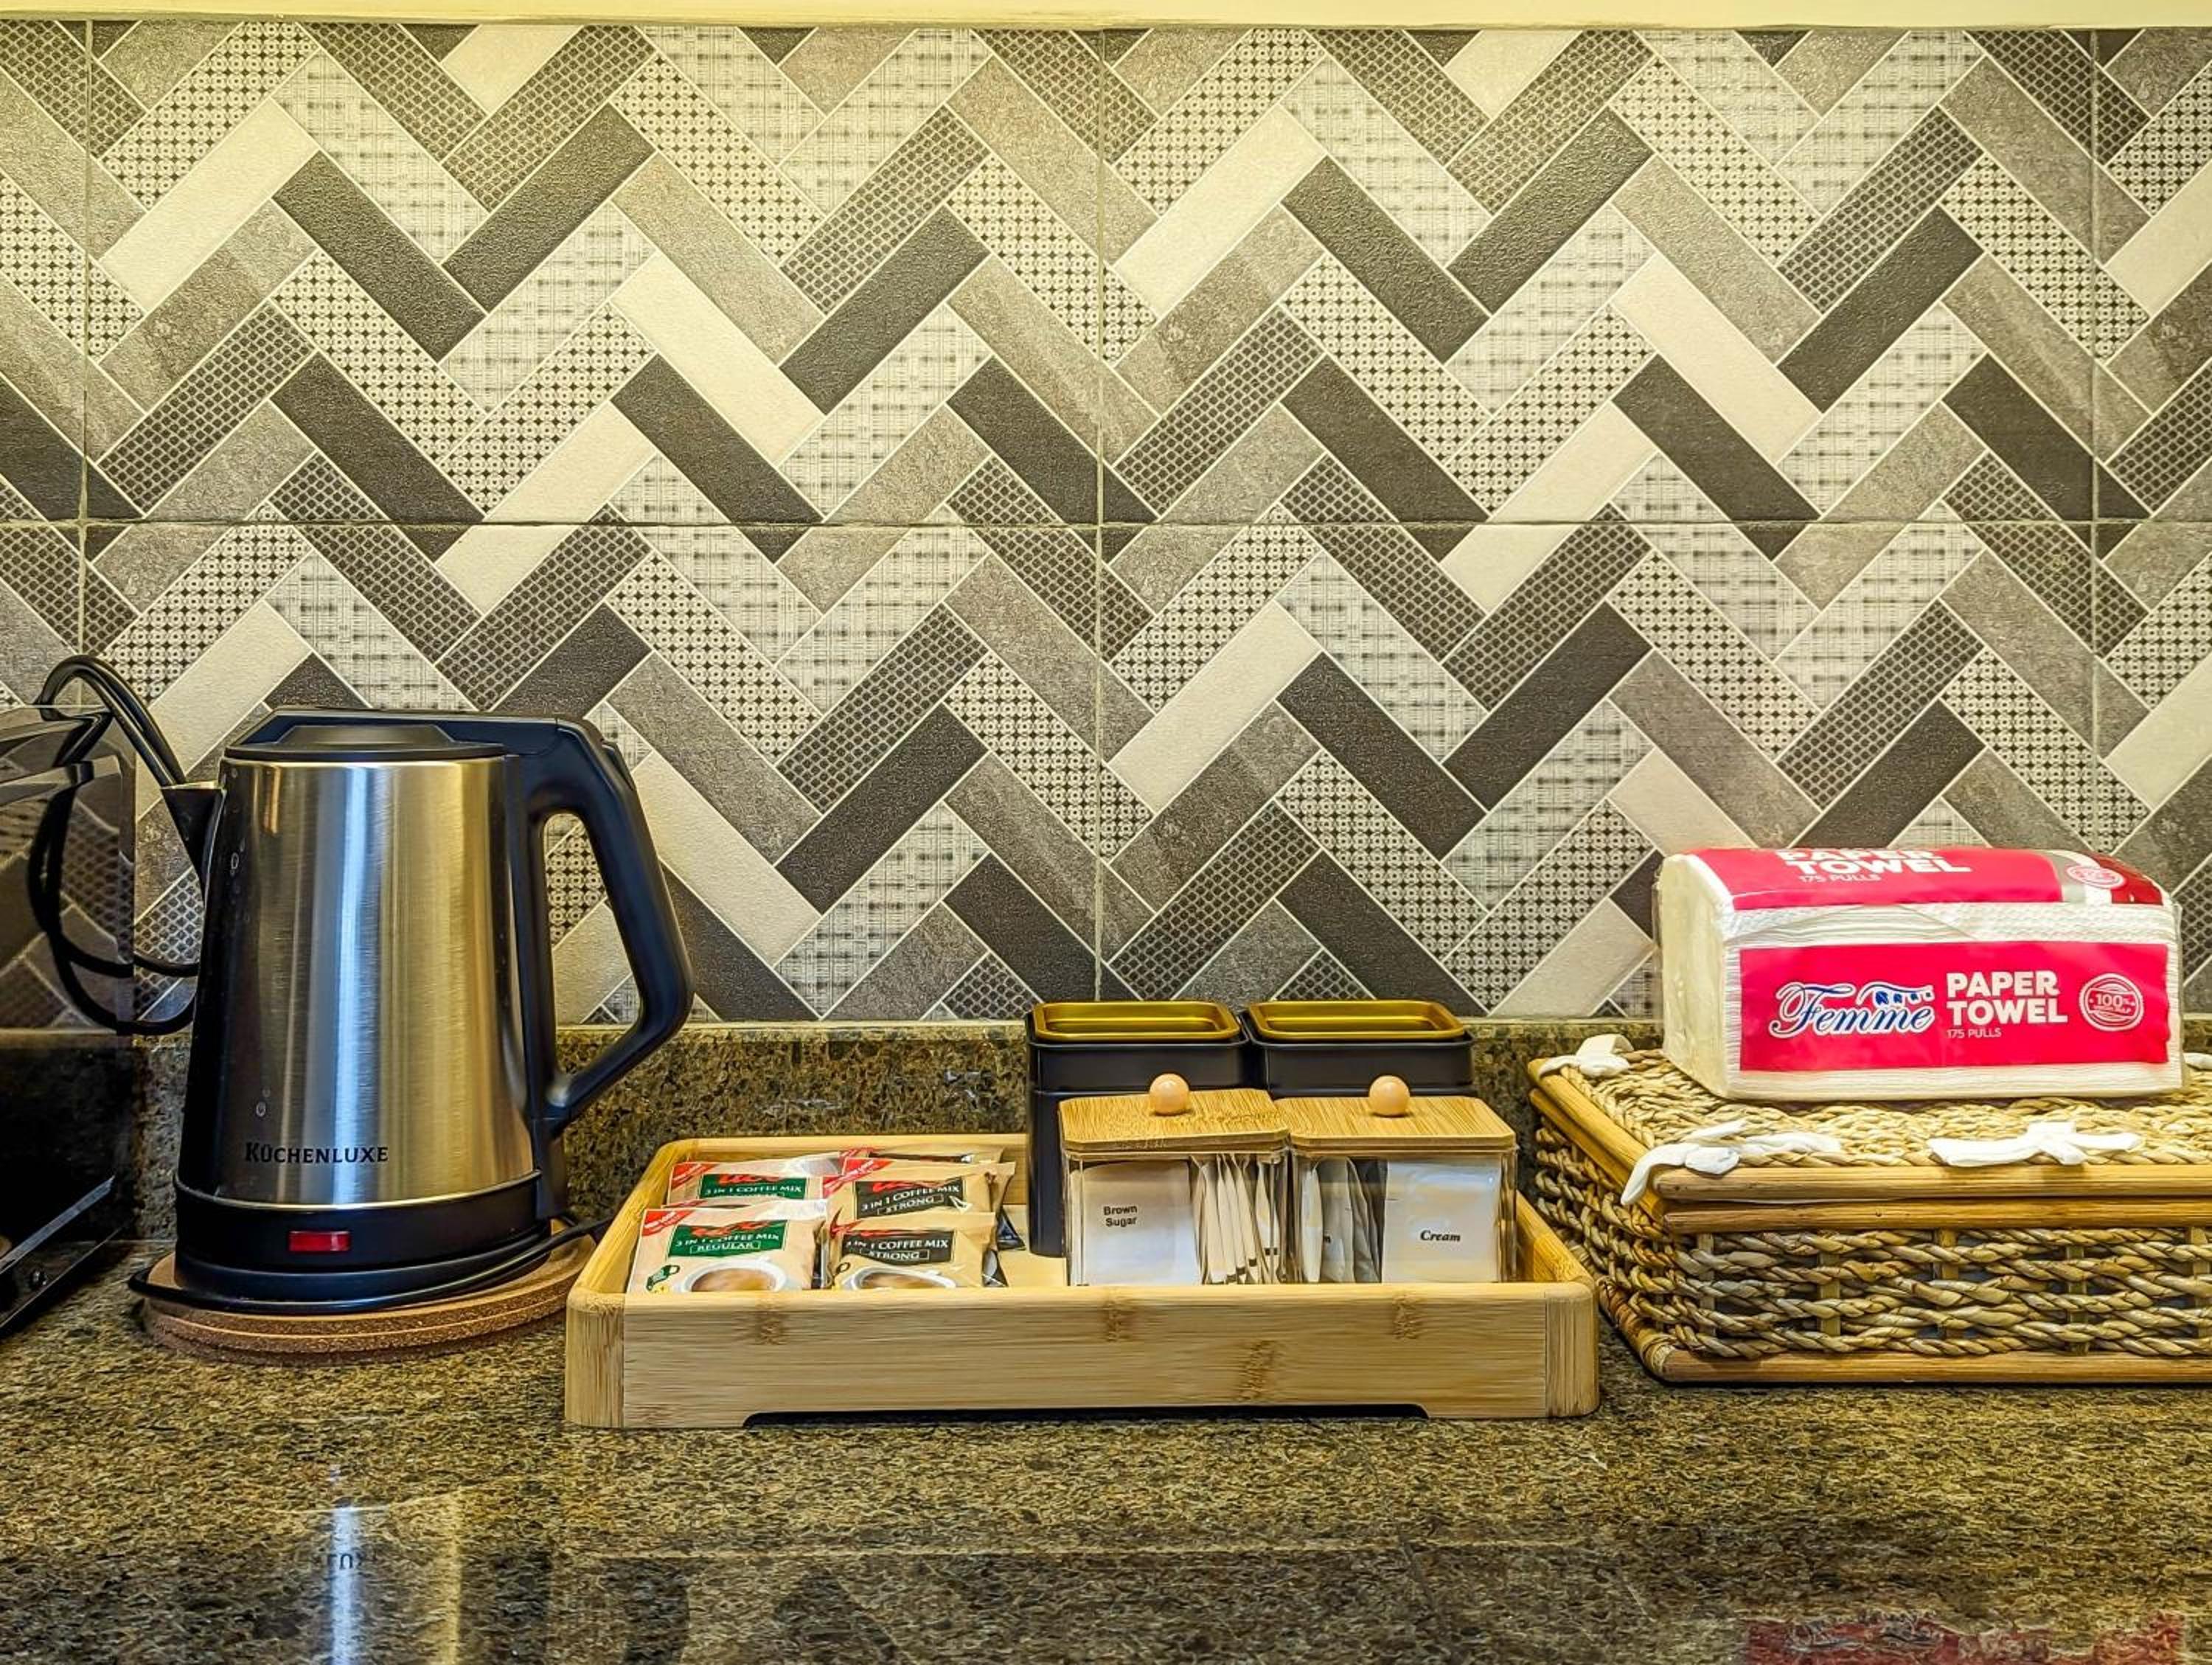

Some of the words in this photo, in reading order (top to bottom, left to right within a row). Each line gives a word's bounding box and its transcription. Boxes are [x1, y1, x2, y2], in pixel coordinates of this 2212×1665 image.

[1775, 849, 1944, 860] PAPER
[1786, 860, 1972, 874] TOWEL
[1829, 874, 1882, 882] PULLS
[1946, 970, 2061, 998] PAPER
[1769, 981, 1935, 1039] Femme
[1946, 998, 2068, 1026] TOWEL
[1947, 1029, 1965, 1038] 175
[1968, 1028, 2002, 1038] PULLS
[870, 1199, 883, 1208] IN
[893, 1186, 936, 1201] COFFEE
[937, 1185, 960, 1193] MIX
[885, 1195, 935, 1214] STRONG
[1104, 1206, 1138, 1216] Brown
[1105, 1217, 1137, 1228] Sugar
[756, 1233, 779, 1241] MIX
[1420, 1229, 1461, 1242] Cream
[697, 1241, 754, 1252] REGULAR
[878, 1240, 923, 1250] COFFEE
[924, 1239, 949, 1248] MIX
[867, 1250, 921, 1261] STRONG
